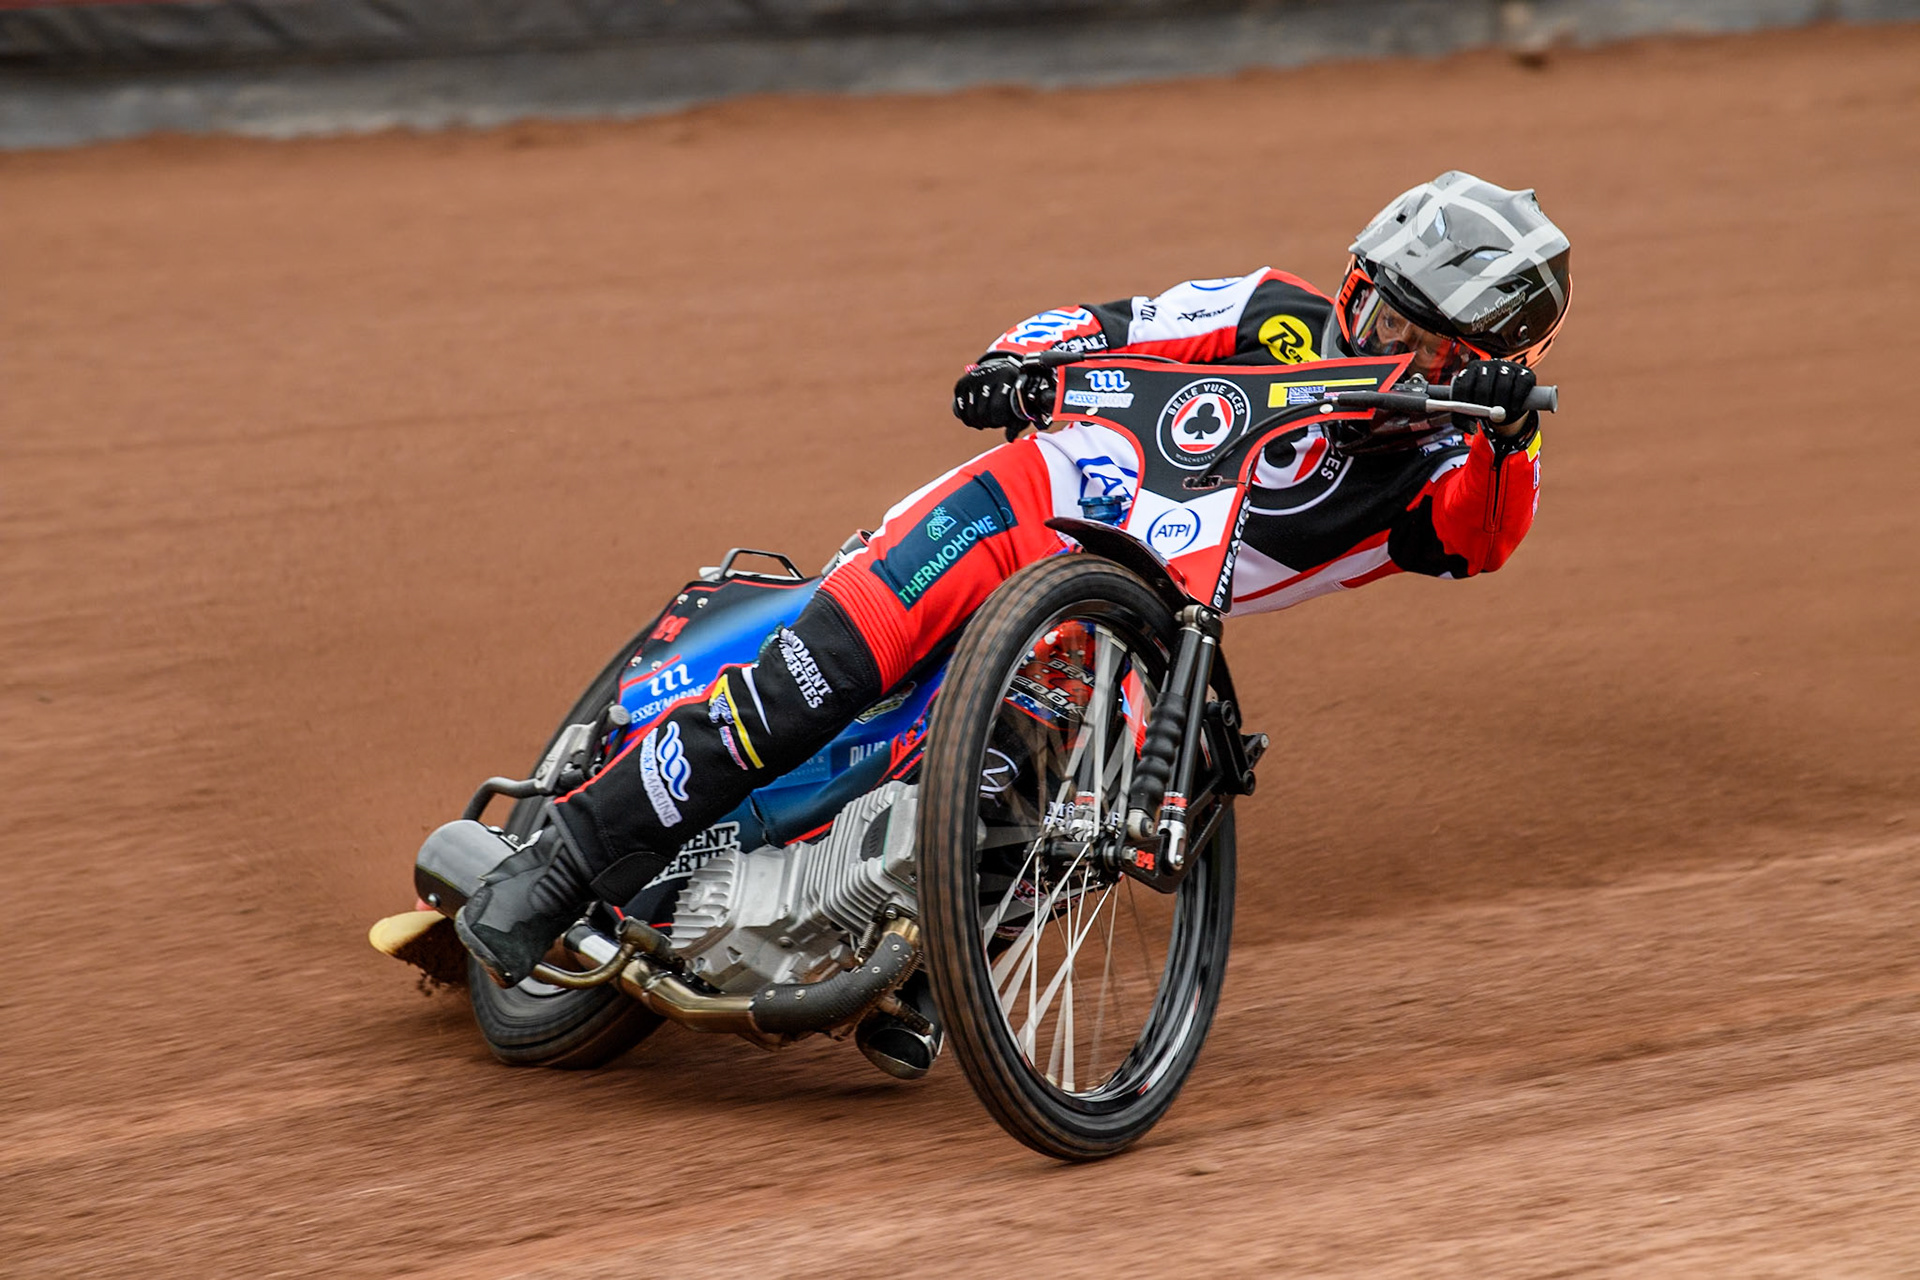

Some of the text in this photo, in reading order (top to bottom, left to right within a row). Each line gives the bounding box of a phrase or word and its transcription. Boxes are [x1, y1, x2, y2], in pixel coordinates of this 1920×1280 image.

[1267, 321, 1310, 362] Ren
[957, 382, 1012, 410] FIST
[1167, 383, 1246, 416] BELLE VUE ACES
[1320, 456, 1341, 480] ES
[1154, 524, 1192, 538] ATPI
[899, 515, 998, 604] THERMOHOME
